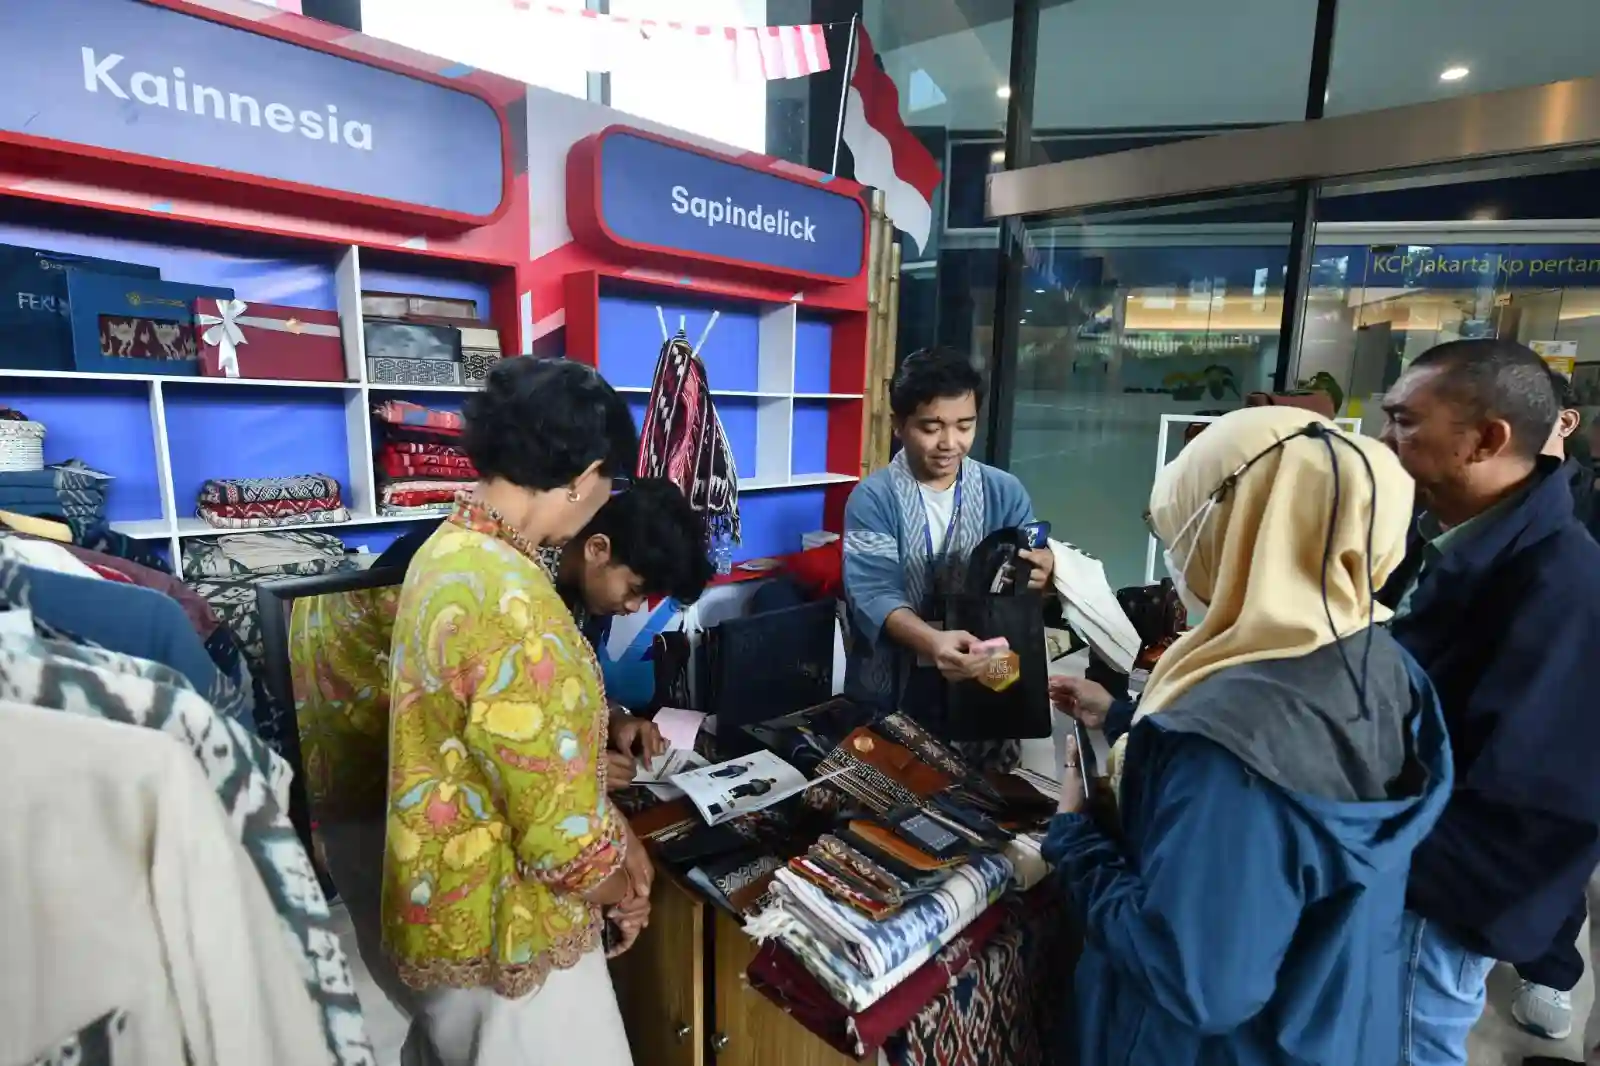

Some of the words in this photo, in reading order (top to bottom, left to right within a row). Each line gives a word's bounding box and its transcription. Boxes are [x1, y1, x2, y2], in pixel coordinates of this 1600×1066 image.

[82, 46, 374, 151] Kainnesia
[671, 185, 816, 243] Sapindelick
[1373, 255, 1413, 274] KCP
[1416, 255, 1490, 276] jakarta
[1497, 255, 1524, 276] kp
